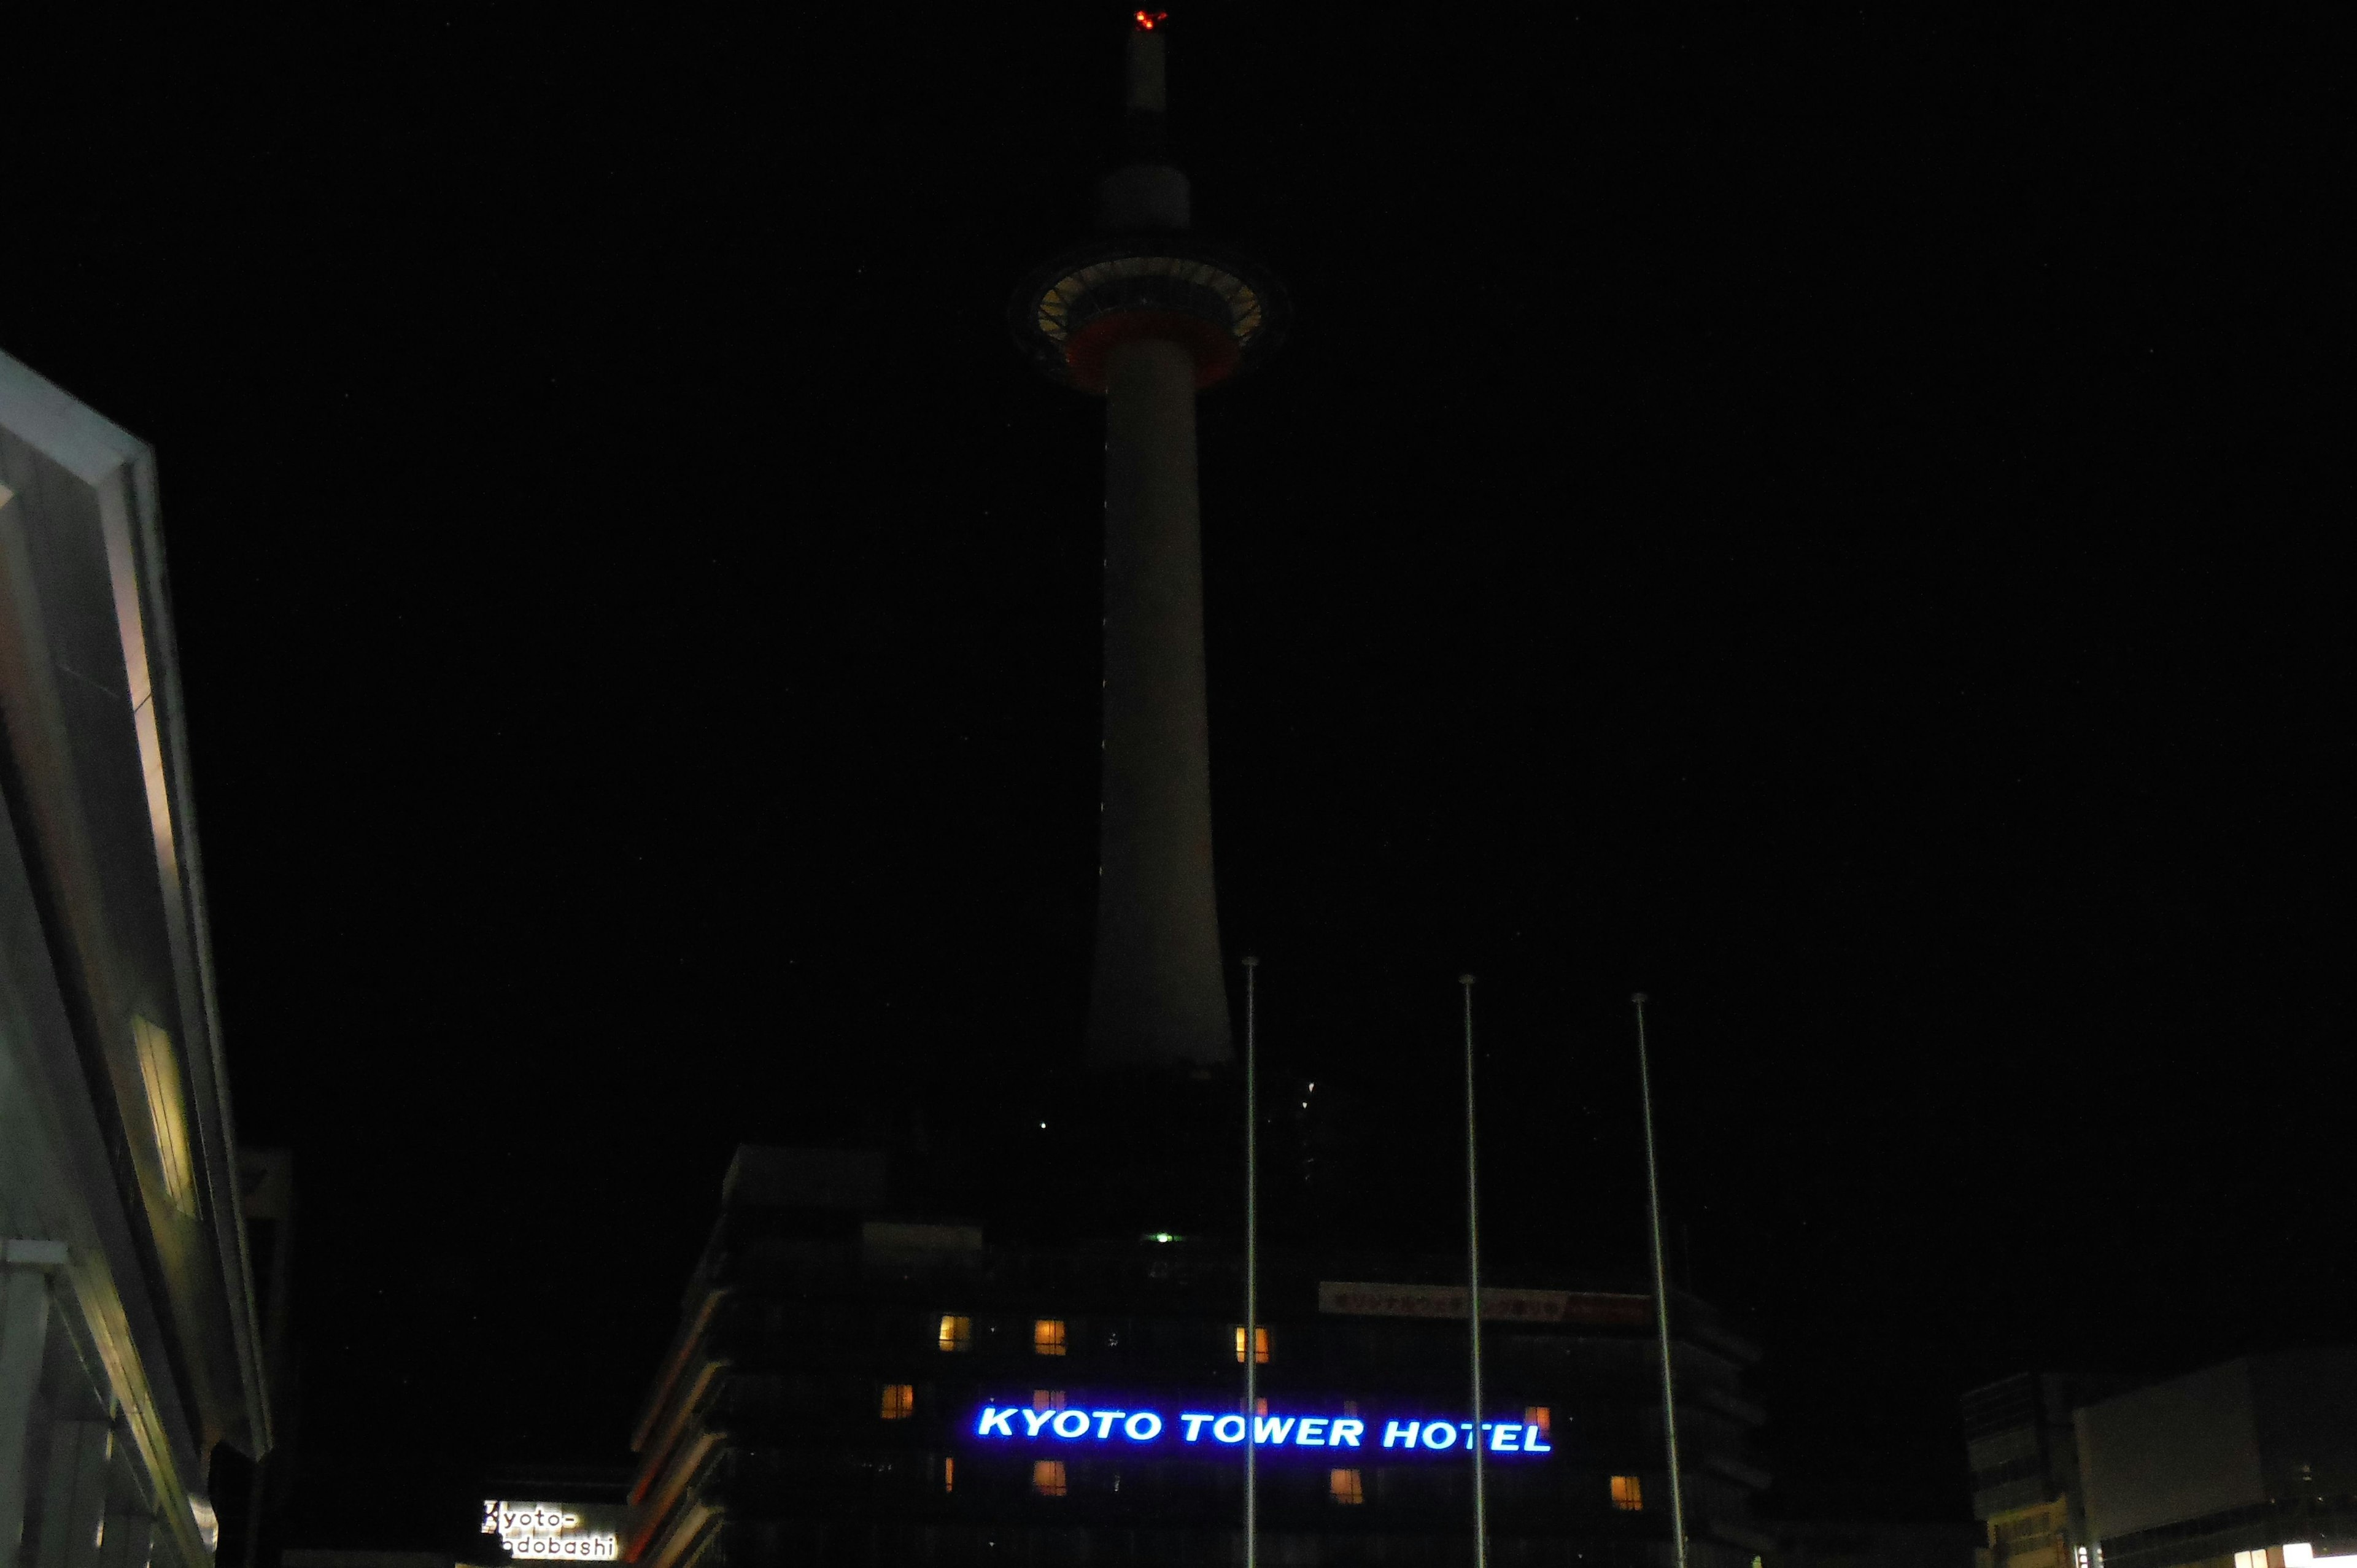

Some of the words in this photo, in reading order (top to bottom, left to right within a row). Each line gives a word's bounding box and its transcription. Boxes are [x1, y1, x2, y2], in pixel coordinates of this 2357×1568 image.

[978, 1407, 1162, 1440] KYOTO
[1180, 1413, 1364, 1447] TOWER
[1382, 1421, 1552, 1453] HOTEL
[501, 1537, 613, 1556] odobashi
